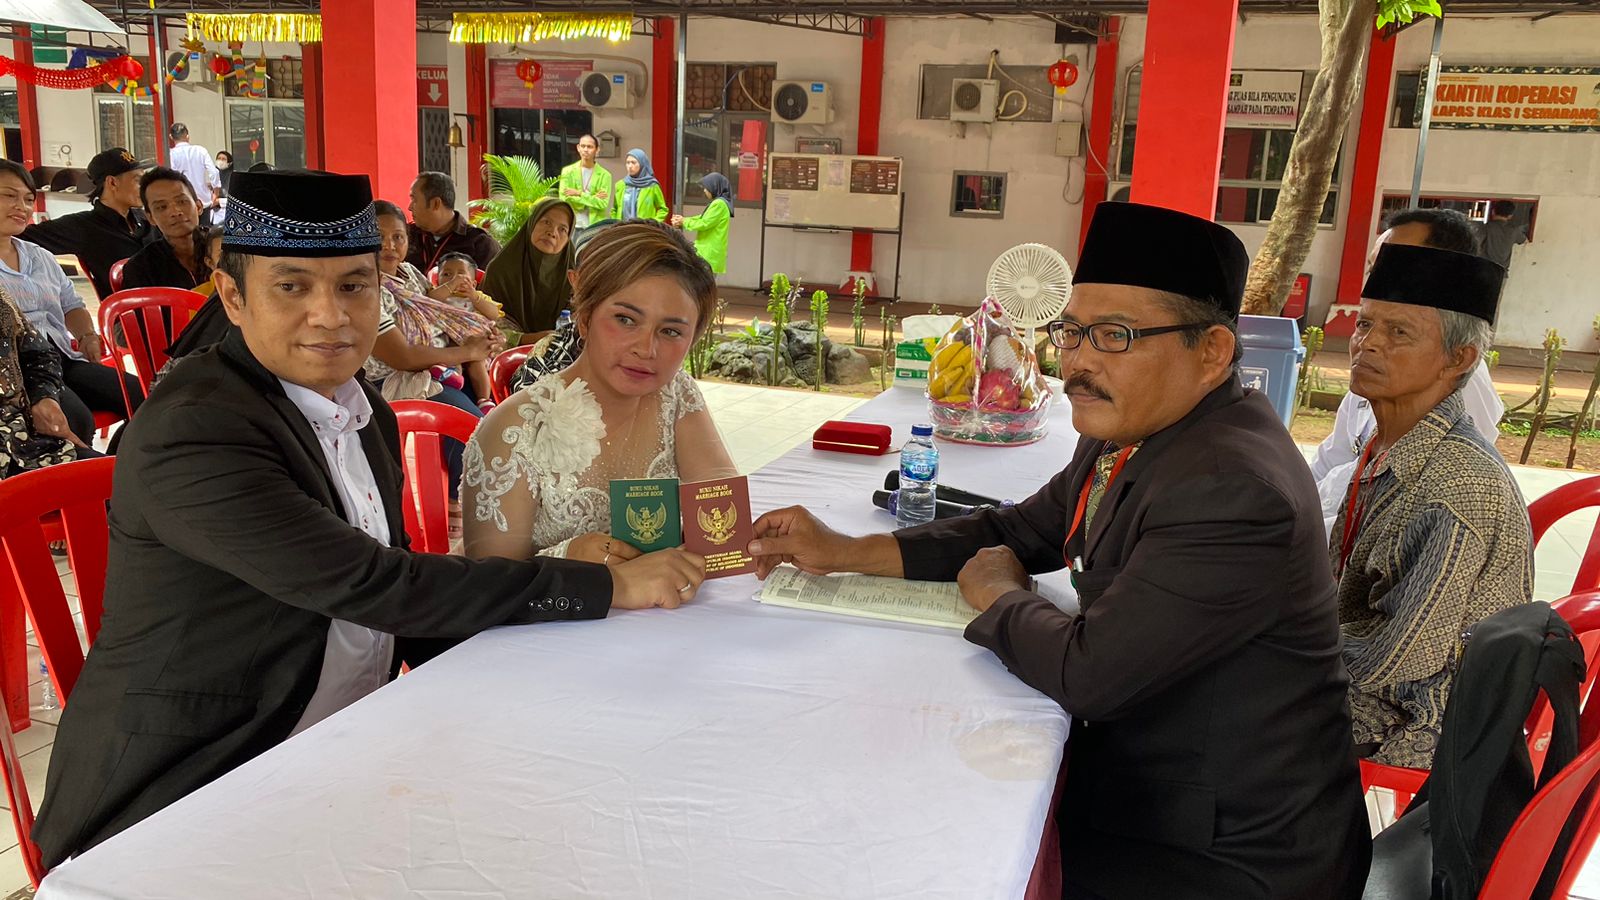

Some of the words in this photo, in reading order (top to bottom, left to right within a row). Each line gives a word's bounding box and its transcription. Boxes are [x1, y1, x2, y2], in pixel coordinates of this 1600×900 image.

[417, 70, 448, 80] KELUA
[1261, 91, 1296, 102] PENGUNJUNG
[1436, 84, 1494, 102] KANTIN
[1496, 85, 1578, 104] KOPERASI
[1248, 104, 1262, 114] PADA
[1263, 105, 1294, 115] TEMPATNYA
[1432, 105, 1474, 117] LAPAS
[1477, 106, 1512, 118] KLAS
[1514, 107, 1520, 119] I
[1522, 107, 1598, 119] SEMARANG
[695, 492, 720, 500] MARRIAGE
[719, 489, 732, 497] BOOK
